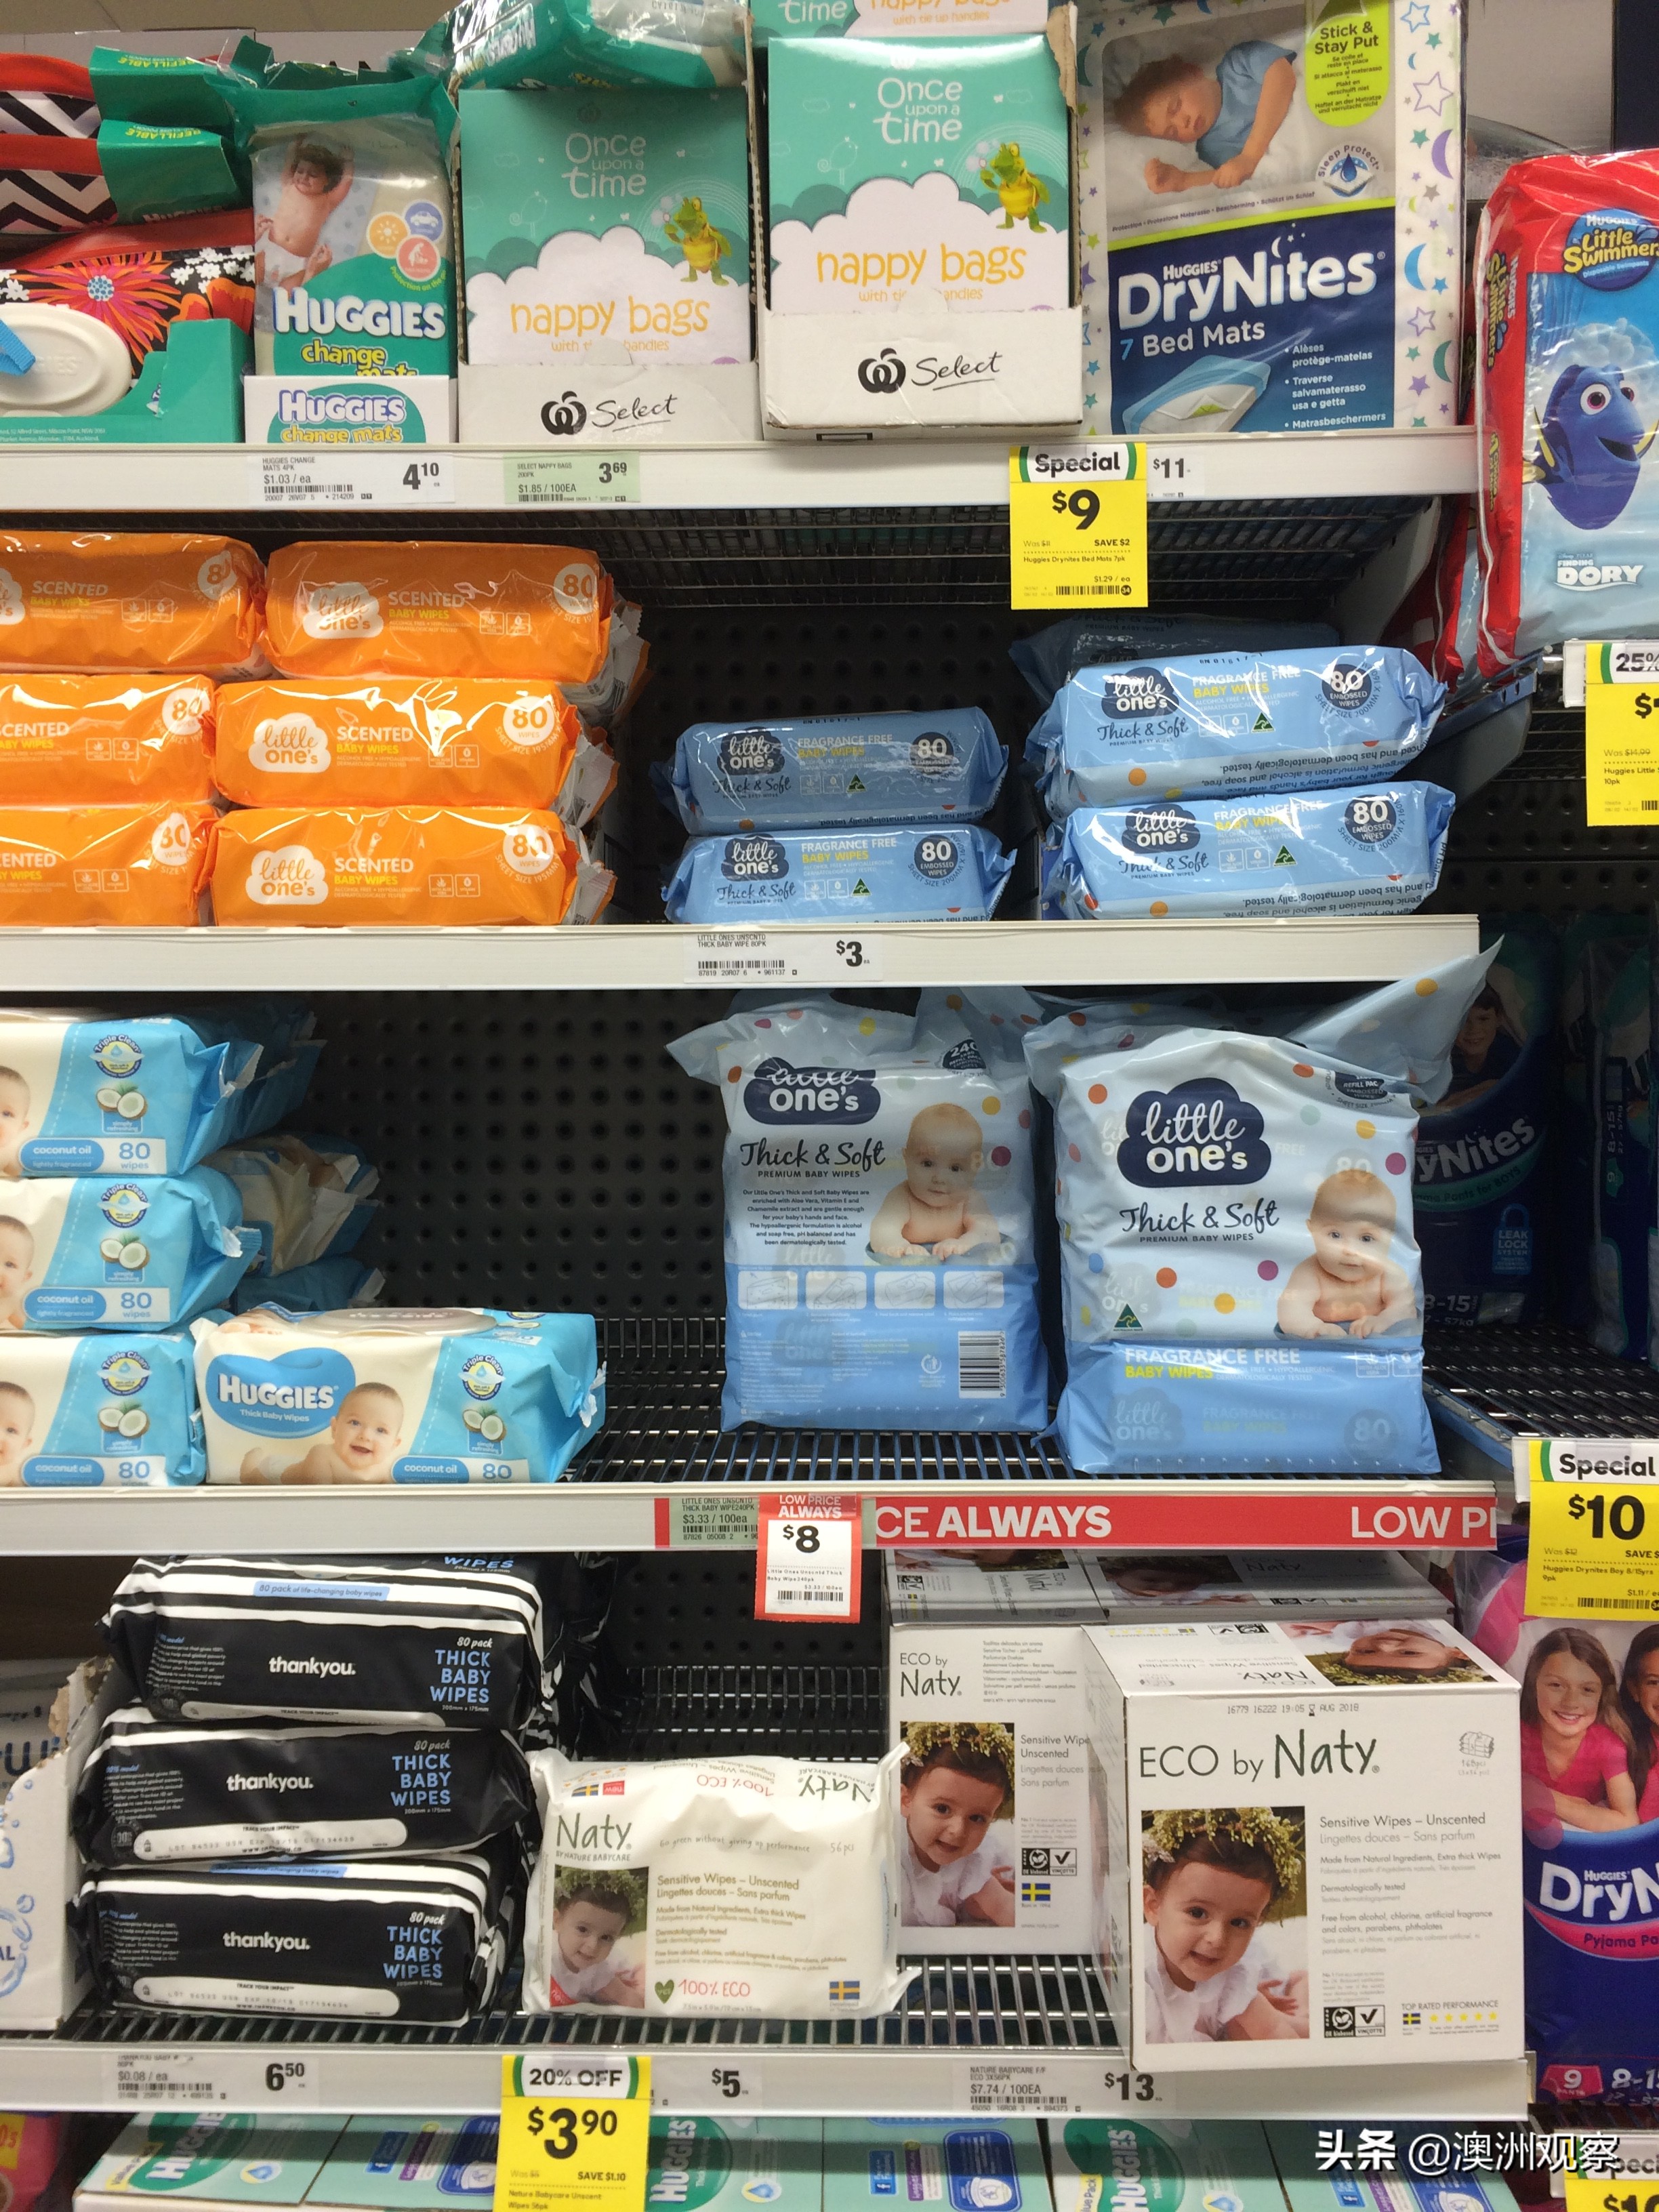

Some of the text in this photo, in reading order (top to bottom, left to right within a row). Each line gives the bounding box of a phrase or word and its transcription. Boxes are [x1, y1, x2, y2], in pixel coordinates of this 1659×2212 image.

[1320, 22, 1372, 40] Stick &
[1315, 35, 1379, 55] Stay Put
[878, 78, 962, 108] Once
[906, 104, 960, 117] upon a
[874, 111, 962, 144] time
[565, 133, 647, 163] Once
[592, 159, 644, 172] upon a
[562, 167, 647, 198] time
[817, 243, 1027, 287] nappy bags
[1163, 260, 1218, 282] HUGGIES
[1119, 243, 1378, 330] DryNites
[859, 290, 888, 302] with
[274, 287, 445, 339] HUGGIES
[510, 295, 710, 337] nappy bags
[1120, 321, 1265, 361] 7 Bed Mats
[1293, 343, 1324, 354] Alèses
[302, 340, 386, 372] change
[1293, 373, 1333, 385] Traverse
[1293, 382, 1366, 398] salvamaterasso
[279, 390, 406, 423] HUGGIES
[1293, 412, 1386, 430] Matrasbeschermers
[281, 428, 403, 443] change mats
[1036, 451, 1120, 478] Special
[1153, 457, 1184, 478] $11
[264, 474, 311, 485] $1.03 ea
[518, 484, 577, 493] $1.85 100EA
[1052, 489, 1100, 530] $9
[1094, 539, 1118, 547] SAVE
[1557, 558, 1594, 568] FINDING
[1557, 563, 1643, 586] DORY
[32, 581, 108, 597] SCENTED
[388, 591, 465, 607] SCENTED
[389, 609, 449, 619] BABY WIPES
[337, 726, 413, 742] SCENTED
[337, 744, 399, 754] BABY WIPES
[802, 837, 897, 852] FRAGRANCE FREE
[922, 842, 951, 861] 80
[802, 851, 869, 863] BABY WIPES
[335, 858, 413, 873] SCENTED
[734, 861, 779, 875] one's
[920, 861, 954, 870] EMBOSSED
[836, 940, 863, 966] $3
[1141, 1100, 1246, 1145] little
[33, 1145, 91, 1155] coconut oil
[119, 1143, 150, 1160] 80
[1147, 1142, 1249, 1174] one's
[121, 1160, 148, 1170] wipes
[1120, 1197, 1279, 1234] Thick & Soft
[1498, 1229, 1528, 1240] LEAK
[1498, 1240, 1528, 1250] LOCK
[37, 1294, 94, 1304] coconut oil
[1125, 1348, 1300, 1364] FRAGRANCE FREE
[218, 1374, 334, 1410] HUGGIES
[240, 1409, 310, 1422] Thick Baby Wipes
[1559, 1454, 1656, 1480] Special
[779, 1495, 841, 1506] LOW PRICE
[683, 1514, 747, 1524] $3.33 100ea
[778, 1506, 842, 1519] ALWAYS
[1568, 1494, 1645, 1540] $10
[937, 1505, 1113, 1538] ALWAYS
[1351, 1506, 1452, 1539] LOW
[783, 1524, 820, 1553] $8
[1625, 1551, 1652, 1559] SAVE
[1576, 1566, 1608, 1574] Drynites
[1610, 1567, 1624, 1575] Boy
[269, 1656, 356, 1678] thankyou.
[900, 1652, 947, 1666] ECO by
[901, 1669, 961, 1697] Naty
[414, 1739, 450, 1751] 80 pack
[1021, 1735, 1061, 1745] Sensitive
[1021, 1748, 1069, 1759] Unscented
[1140, 1729, 1377, 1782] ECO by Naty
[392, 1754, 451, 1771] THICK
[400, 1771, 451, 1789] BABY
[390, 1790, 451, 1807] WIPES
[1320, 1812, 1486, 1828] Sensitive Wipes Unscented
[1320, 1829, 1475, 1846] Lingettes douces Sans parfum
[657, 1873, 799, 1891] Sensitive Wipes Unscented
[1322, 1883, 1406, 1894] Dermatologically tested
[657, 1887, 790, 1902] Lingettes douces Sans parfum
[1401, 2000, 1498, 2011] TOP RATED PERFORMANCE
[529, 2068, 622, 2087] 20% OFF
[712, 2069, 740, 2098] $5
[970, 2084, 1042, 2095] $7.74 100EA
[1105, 2073, 1155, 2102] $13
[577, 2171, 626, 2182] SAVE $1.10
[508, 2190, 601, 2200] Nature Babycare Unscent
